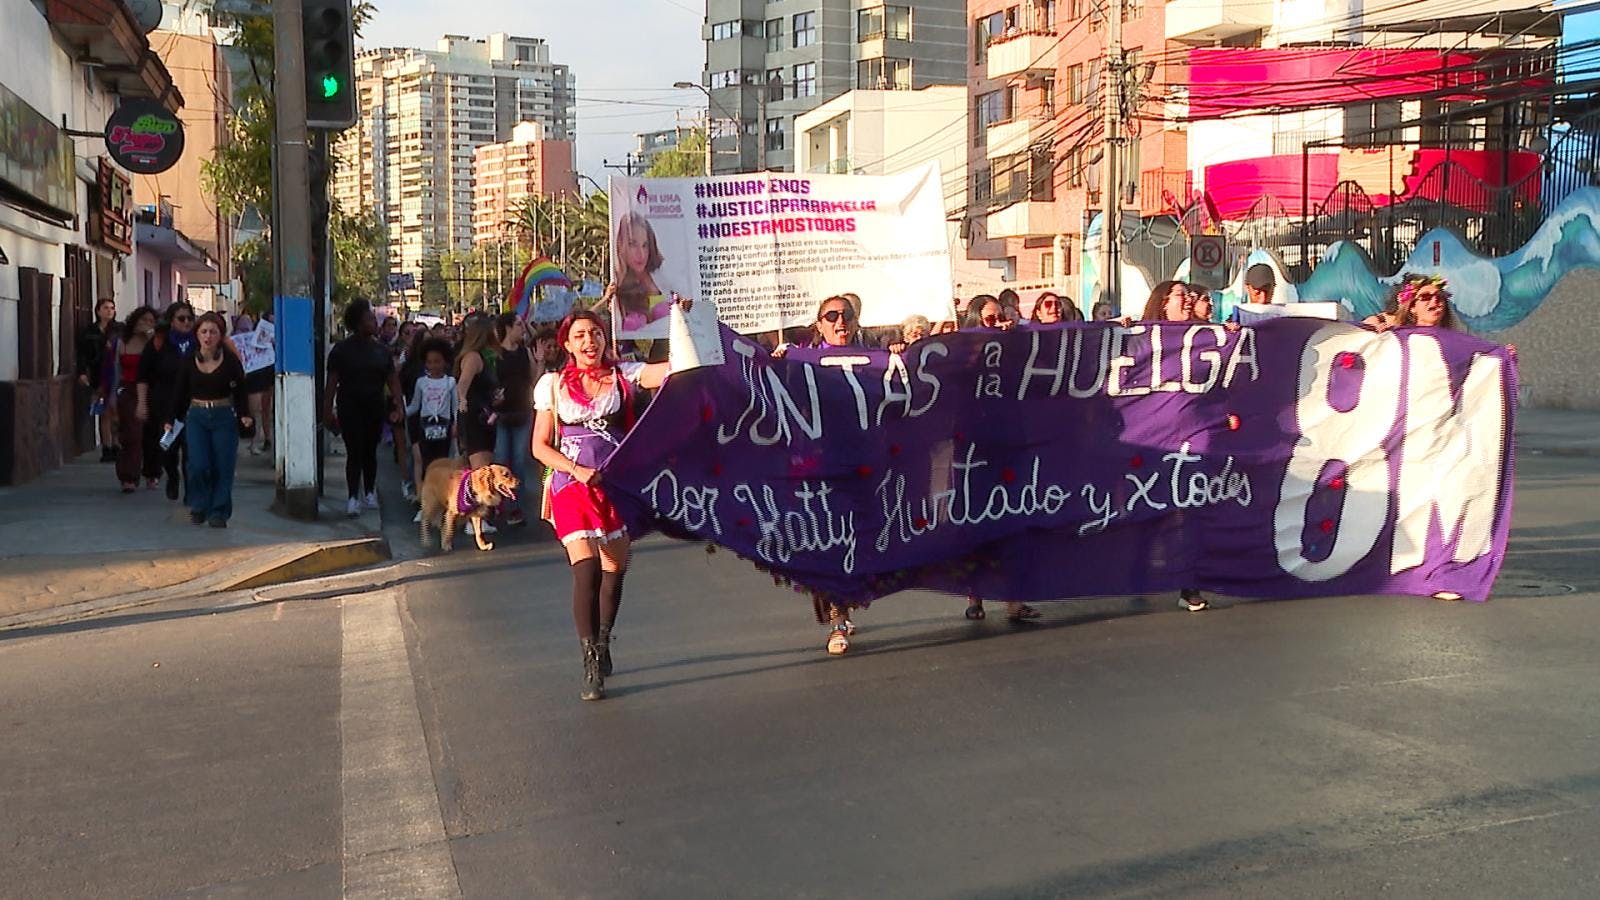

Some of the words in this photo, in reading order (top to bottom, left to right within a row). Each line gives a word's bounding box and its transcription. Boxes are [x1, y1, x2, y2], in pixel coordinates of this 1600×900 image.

[698, 217, 856, 239] #NOESTAMOSTODAS
[714, 253, 735, 262] creyó
[720, 262, 744, 271] pareja
[699, 271, 735, 279] Violencia
[736, 270, 750, 278] que
[700, 280, 712, 288] Me
[713, 287, 732, 296] dañó
[732, 294, 771, 303] constante
[720, 304, 745, 313] pronto
[1016, 324, 1260, 401] HUELGA
[1273, 323, 1502, 581] 8M
[641, 468, 722, 536] Por
[733, 480, 857, 574] Katty
[874, 442, 1072, 552] Hurtado
[1078, 483, 1118, 535] y
